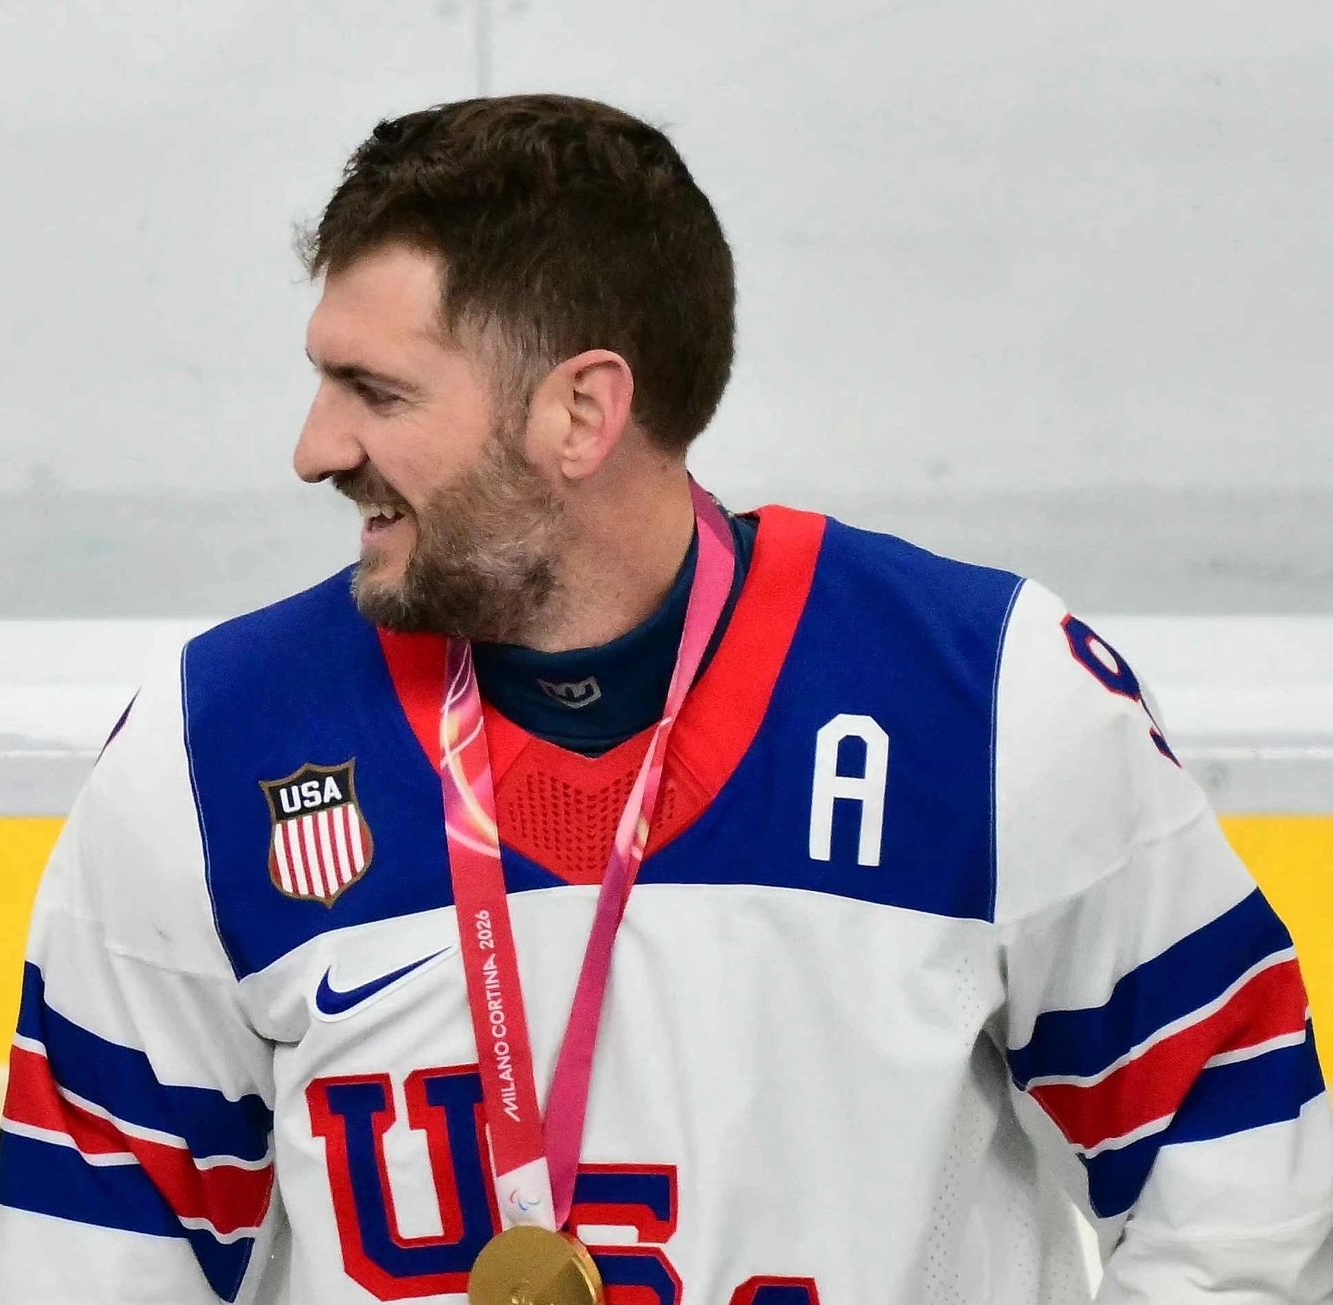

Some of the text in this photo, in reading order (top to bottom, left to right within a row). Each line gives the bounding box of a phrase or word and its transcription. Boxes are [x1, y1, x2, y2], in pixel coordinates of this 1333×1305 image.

[279, 776, 343, 814] USA
[808, 713, 890, 867] A
[474, 909, 520, 1123] MILANO CORTINA 2026
